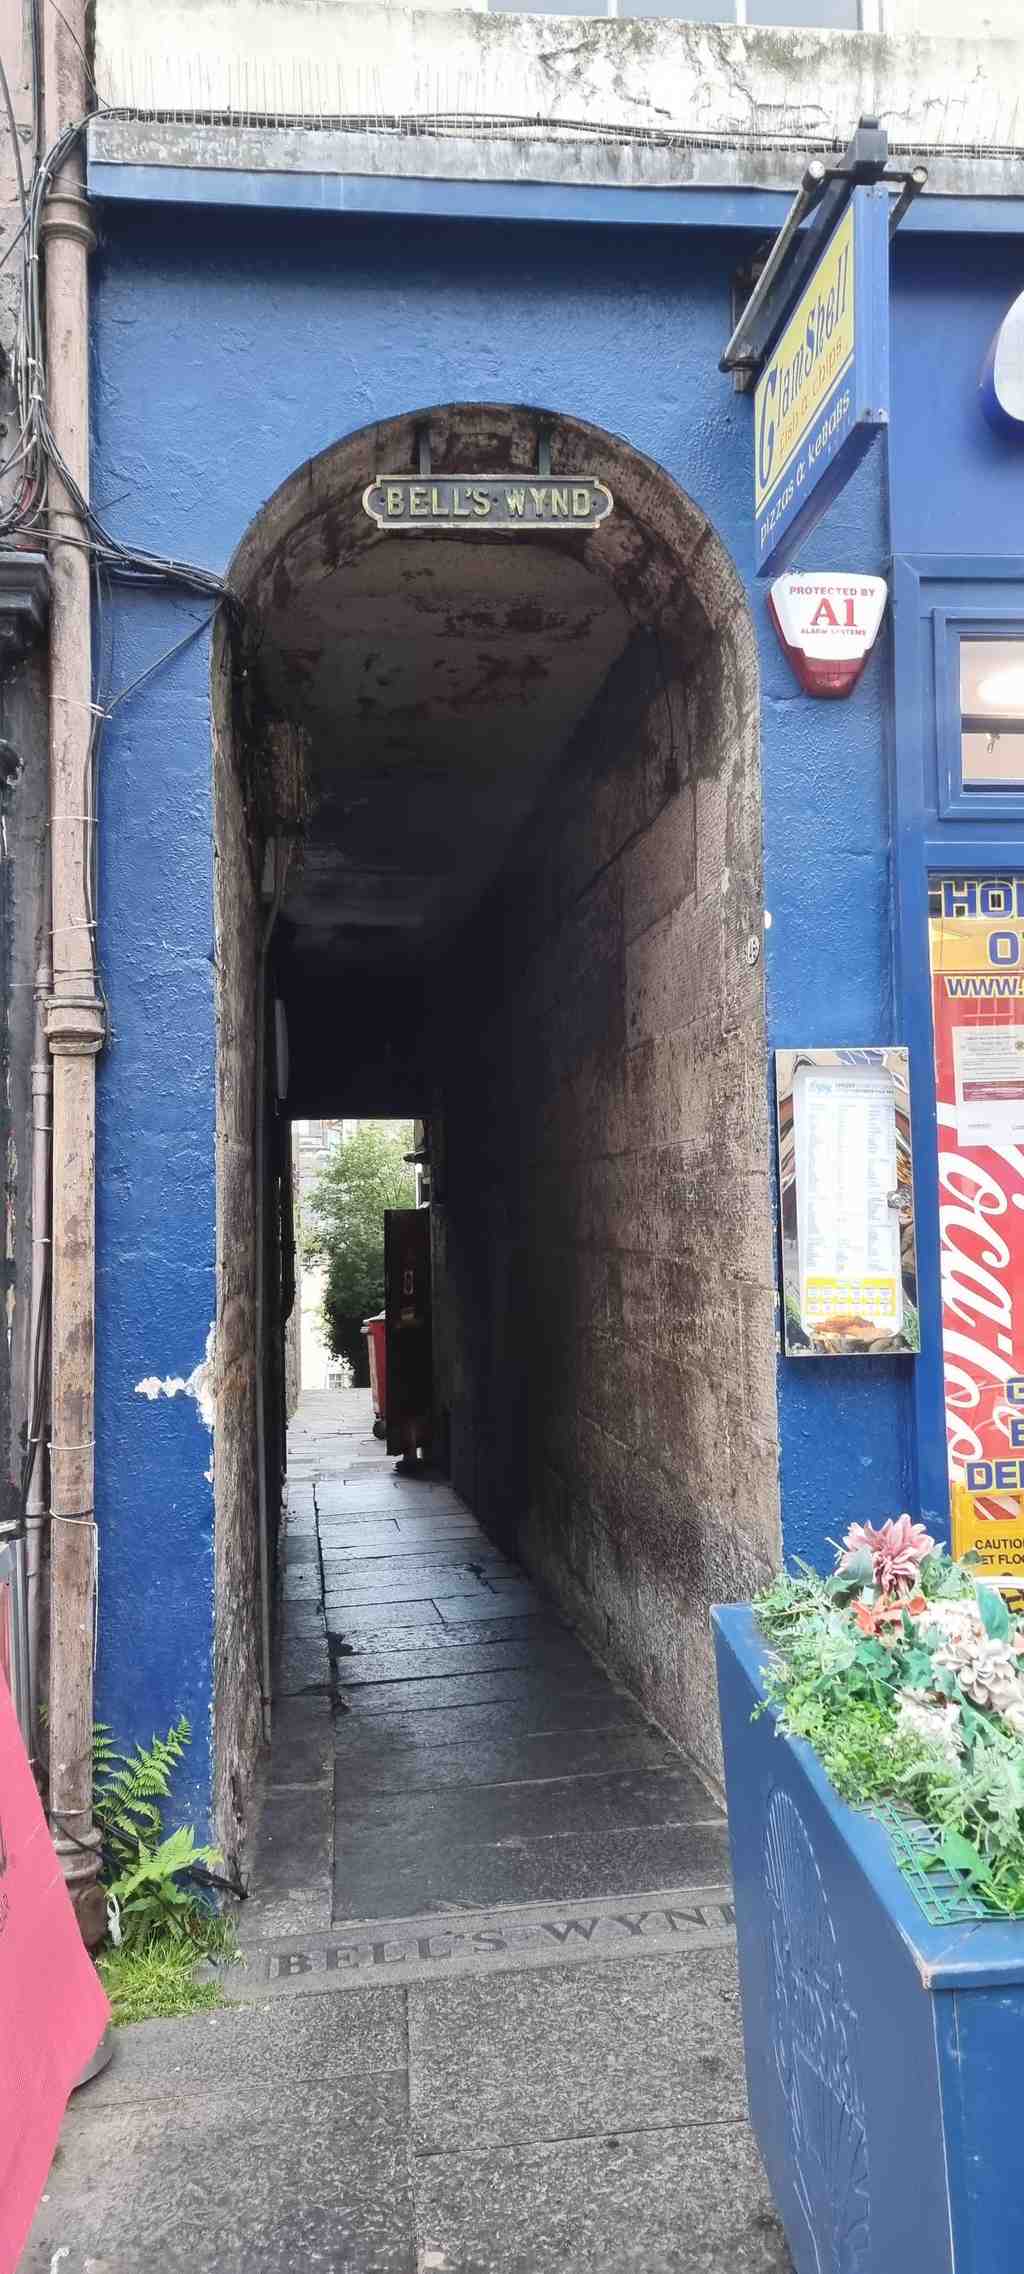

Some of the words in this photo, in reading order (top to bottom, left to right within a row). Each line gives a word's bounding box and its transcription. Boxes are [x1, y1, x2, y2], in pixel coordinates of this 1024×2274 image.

[387, 487, 490, 517] BELL'S
[504, 487, 592, 518] WYND
[789, 586, 858, 596] PROTECTED
[860, 587, 876, 597] BY
[975, 1538, 1024, 1550] CAUTIO
[268, 1928, 508, 1981] BELL'S
